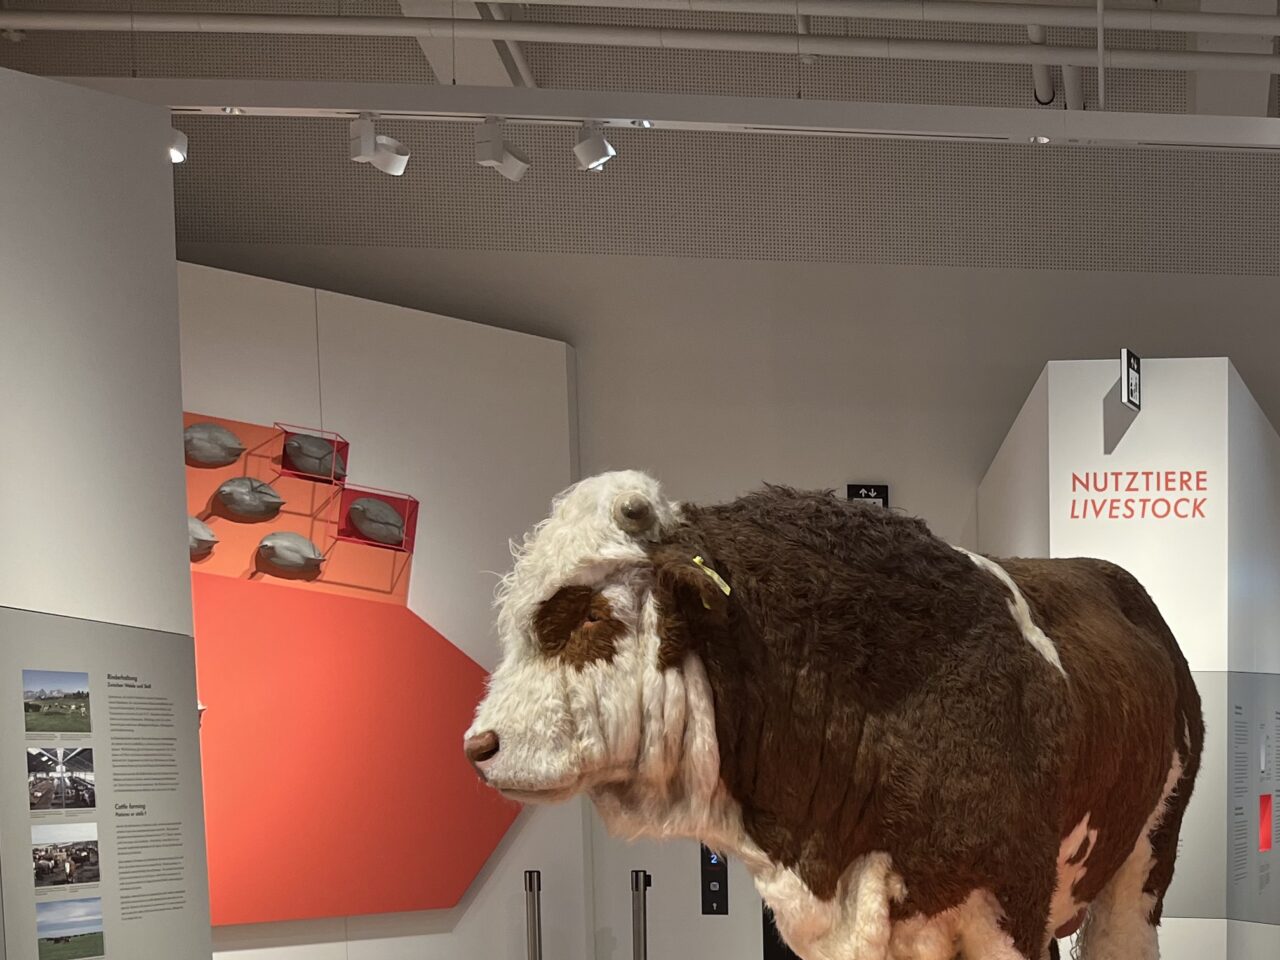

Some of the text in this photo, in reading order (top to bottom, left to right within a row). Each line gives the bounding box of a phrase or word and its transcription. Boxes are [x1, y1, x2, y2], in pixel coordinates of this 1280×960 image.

[1071, 470, 1208, 493] NUTZTIERE
[1070, 497, 1208, 519] LIVESTOCK
[710, 854, 718, 864] 2
